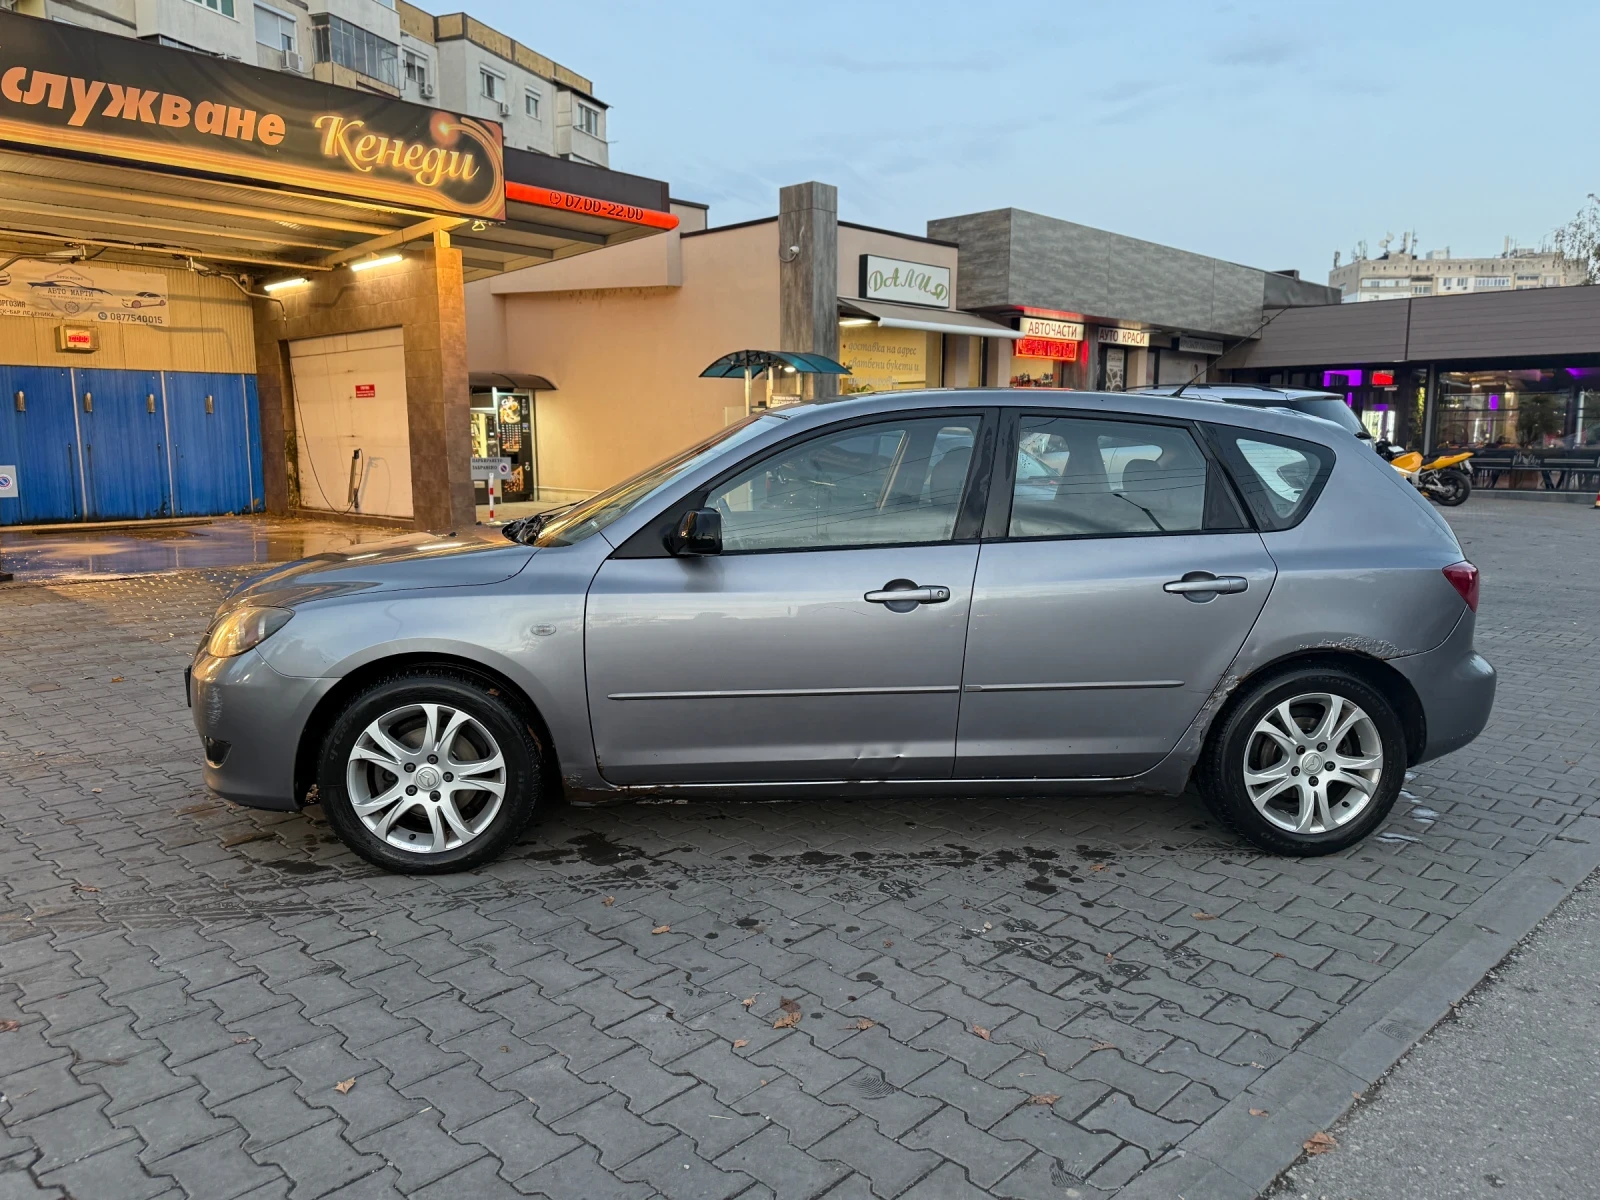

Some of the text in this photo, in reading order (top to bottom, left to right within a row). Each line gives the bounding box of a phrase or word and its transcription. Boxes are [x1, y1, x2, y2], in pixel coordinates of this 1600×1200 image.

[1, 66, 480, 187] служване Кенеди
[565, 194, 644, 221] 07.00-22.00
[47, 287, 95, 298] АВТО МАРТИ
[110, 312, 163, 325] 0877540015
[1028, 321, 1077, 338] АВТОЧАСТИ
[1099, 328, 1145, 345] АУТО КРАСИ
[848, 341, 917, 357] доставка на адрес
[886, 358, 913, 372] букети
